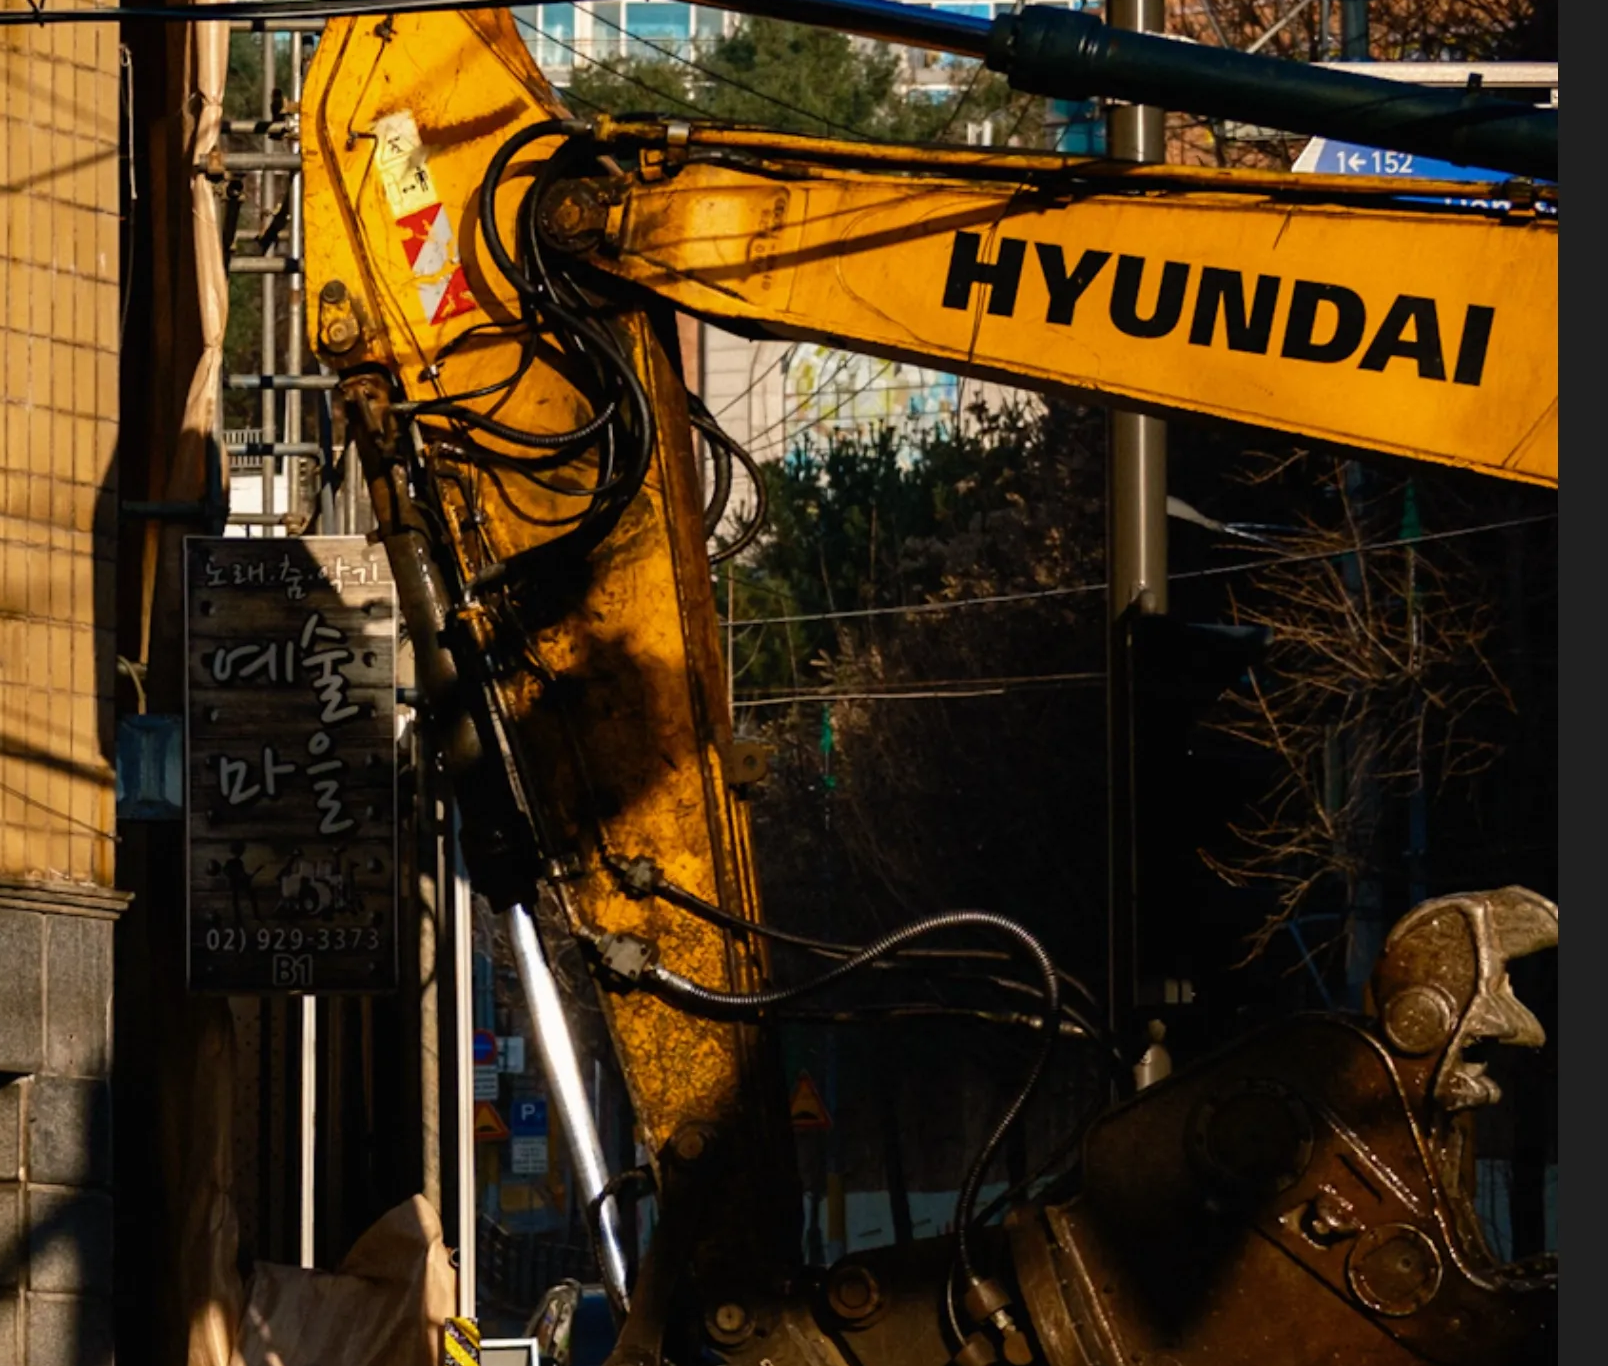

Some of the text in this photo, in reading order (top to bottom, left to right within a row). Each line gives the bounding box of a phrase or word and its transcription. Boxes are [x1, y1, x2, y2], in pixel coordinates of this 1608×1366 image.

[940, 231, 1495, 386] HYUNDAI
[212, 612, 359, 724] 예술
[219, 732, 355, 835] 마을
[205, 927, 380, 954] 02) 929-3373
[272, 953, 314, 987] B1
